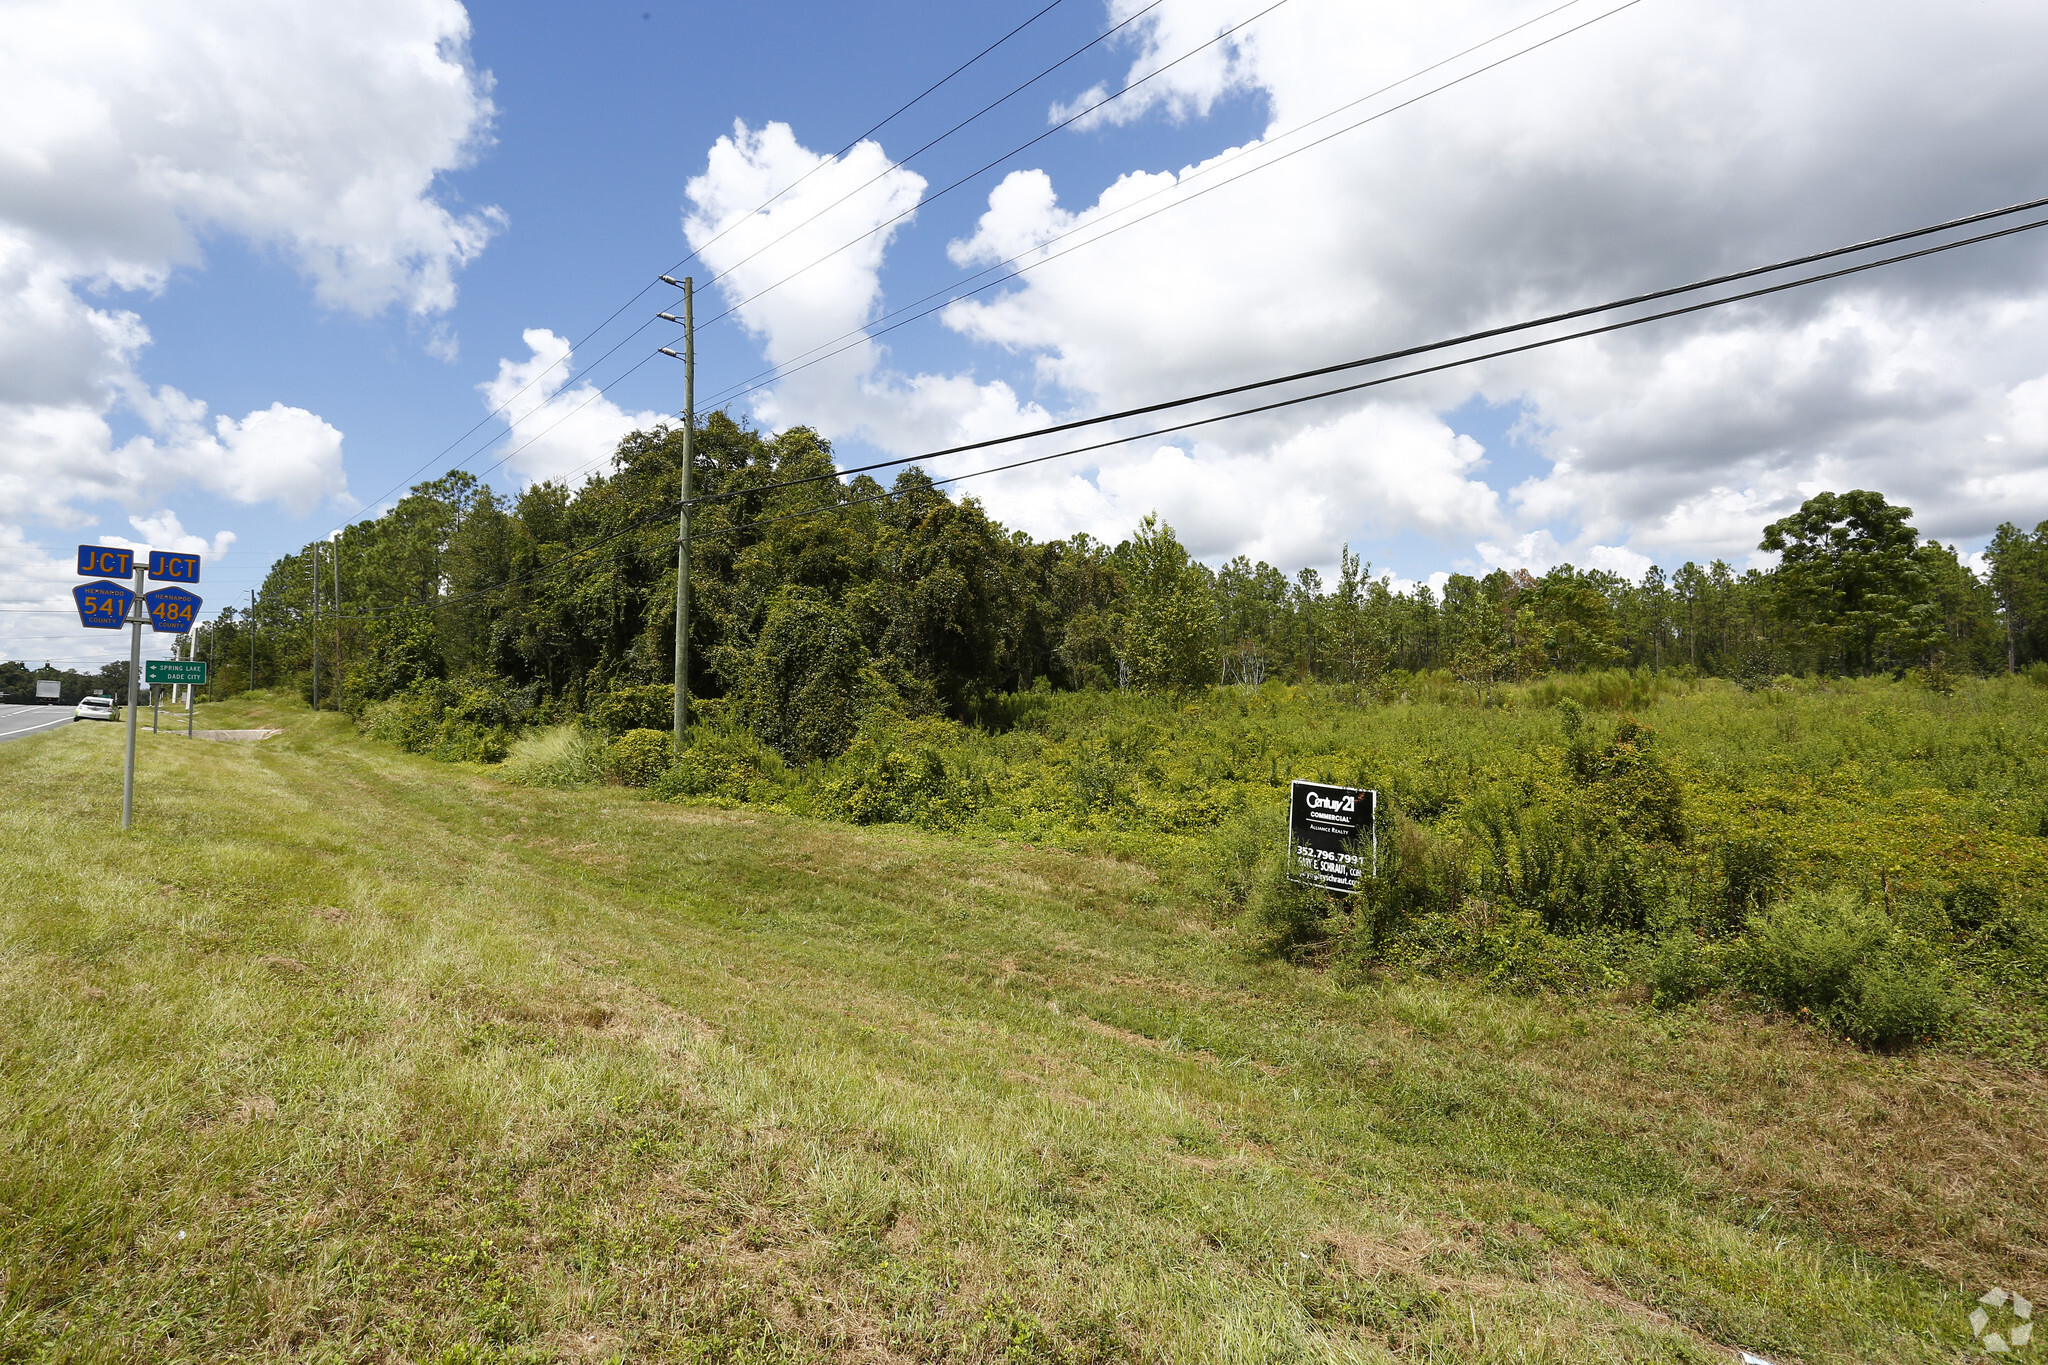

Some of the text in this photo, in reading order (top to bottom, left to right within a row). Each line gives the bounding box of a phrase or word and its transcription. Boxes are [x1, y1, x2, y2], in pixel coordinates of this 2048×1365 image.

[82, 552, 130, 573] JCT
[152, 557, 197, 577] JCT
[84, 588, 124, 597] HERNANDO
[155, 594, 192, 602] HERNANDO
[84, 596, 124, 616] 541
[152, 602, 192, 621] 484
[158, 621, 185, 629] COUNTY
[1306, 791, 1355, 812] Century 21
[1310, 811, 1350, 822] COMMERCIAL
[1331, 827, 1349, 835] REALTY
[1297, 845, 1363, 864] 352.796.7991
